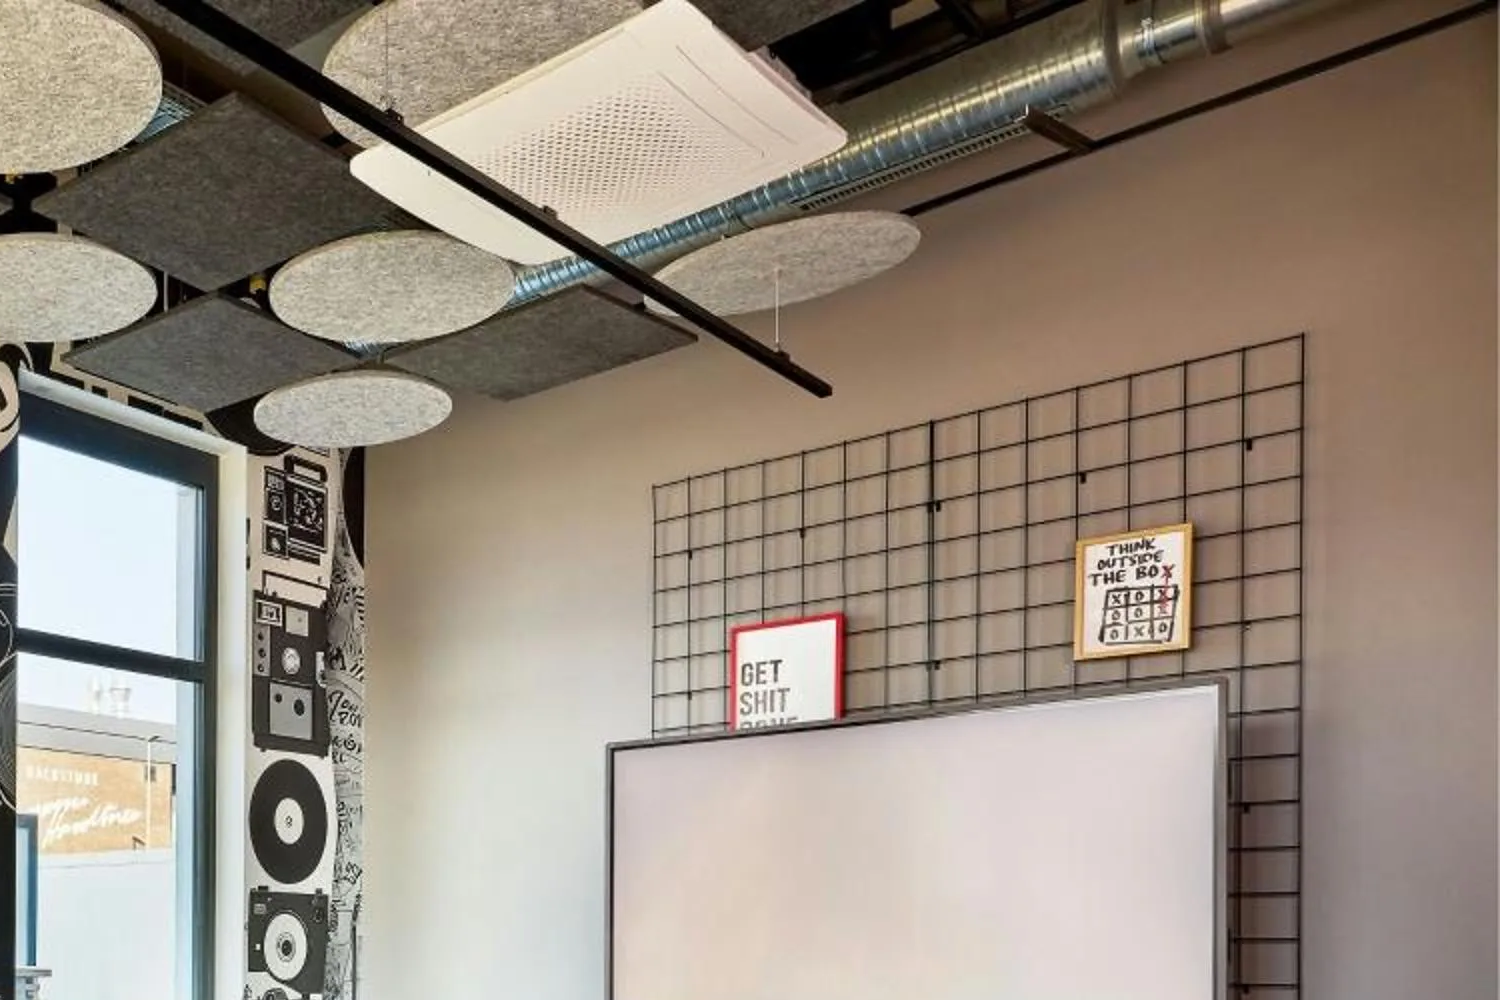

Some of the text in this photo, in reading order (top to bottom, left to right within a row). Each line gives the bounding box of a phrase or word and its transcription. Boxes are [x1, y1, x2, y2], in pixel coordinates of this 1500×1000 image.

[1106, 538, 1156, 556] THINK
[1097, 550, 1164, 570] OUTSIDE
[1088, 564, 1175, 586] THE BOX
[741, 659, 783, 687] GET
[740, 687, 791, 716] SHIT
